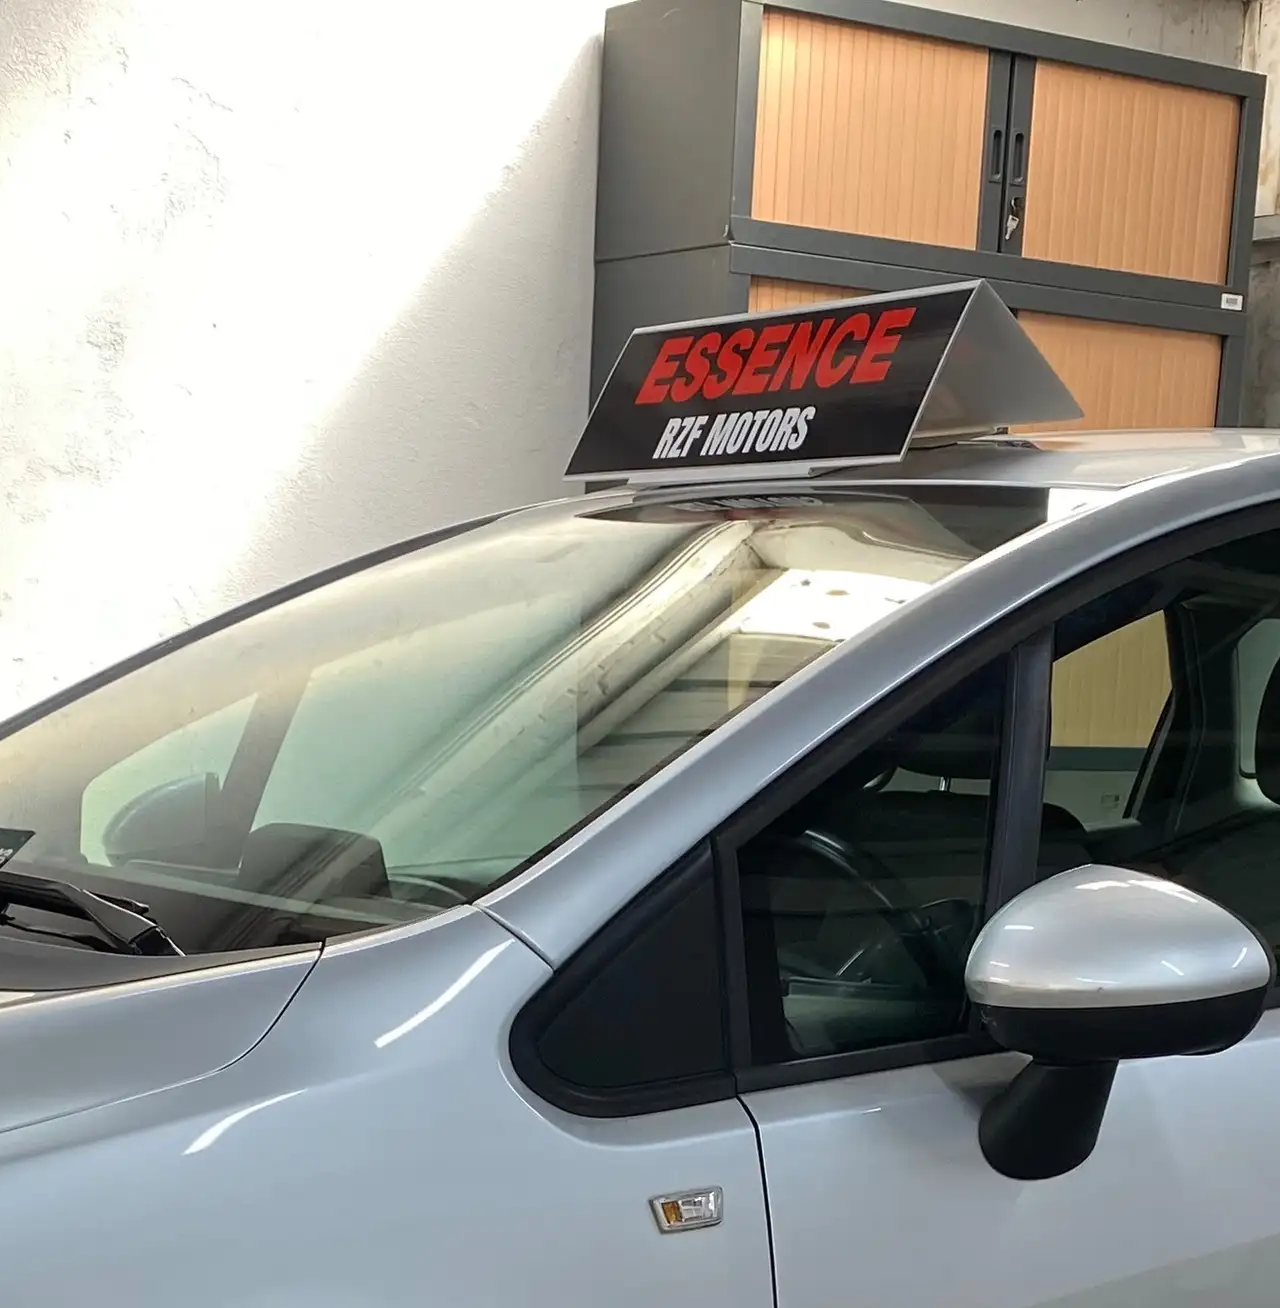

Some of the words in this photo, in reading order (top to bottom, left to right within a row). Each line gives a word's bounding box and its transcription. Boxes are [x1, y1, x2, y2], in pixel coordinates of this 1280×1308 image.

[634, 306, 917, 405] ESSENCE
[652, 415, 710, 459] RZF
[699, 406, 816, 457] MOTORS
